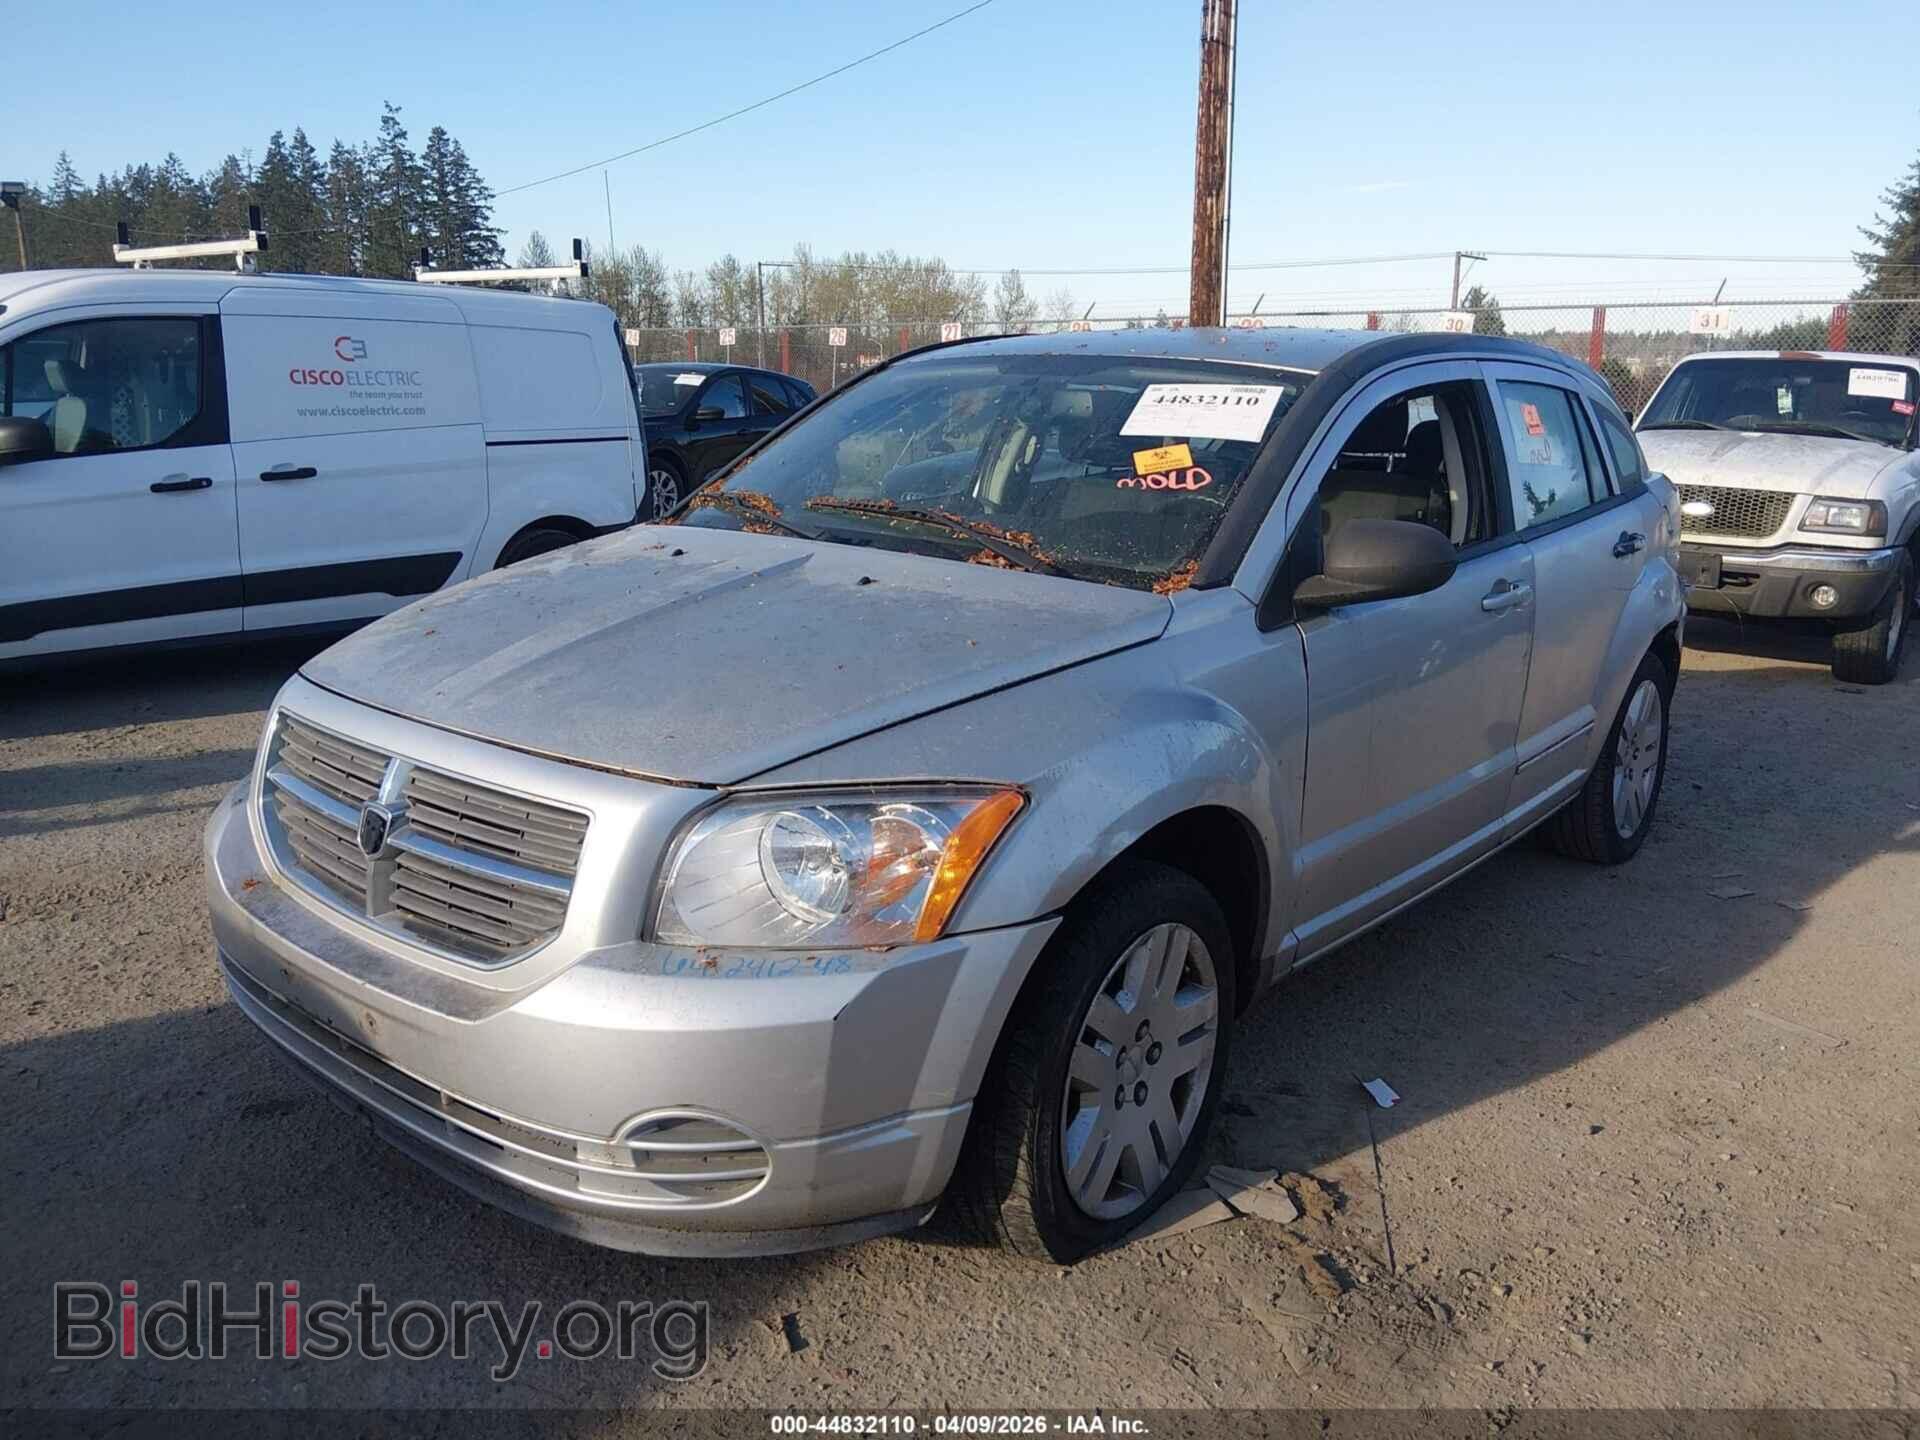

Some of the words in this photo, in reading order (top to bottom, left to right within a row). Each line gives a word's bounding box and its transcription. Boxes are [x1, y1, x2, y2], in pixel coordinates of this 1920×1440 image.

[1445, 318, 1464, 331] 30
[1700, 314, 1720, 328] 31
[720, 329, 735, 344] 25
[944, 324, 960, 339] 27
[1151, 394, 1260, 406] 44832110
[297, 405, 426, 417] www.ciscoelectric.com
